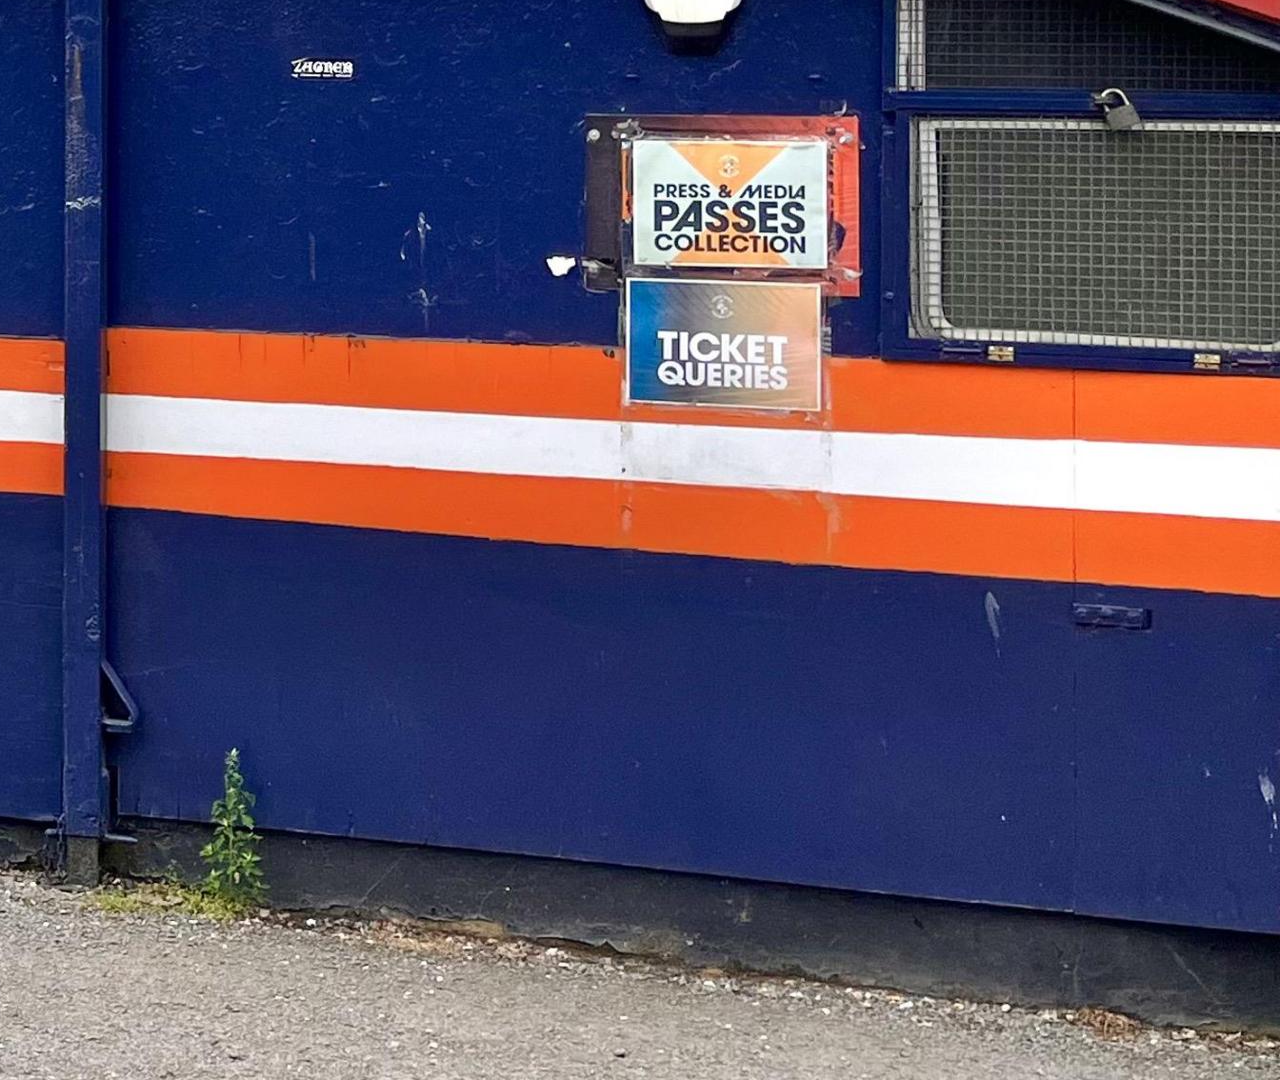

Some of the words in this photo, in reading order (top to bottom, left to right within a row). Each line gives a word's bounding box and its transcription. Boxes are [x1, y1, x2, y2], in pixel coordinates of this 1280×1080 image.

[653, 184, 710, 198] PRESS
[718, 184, 732, 198] &
[740, 184, 806, 200] MEDIA
[653, 200, 806, 234] PASSES
[654, 234, 806, 253] COLLECTION
[657, 331, 788, 364] TICKET
[657, 362, 788, 390] QUERIES
